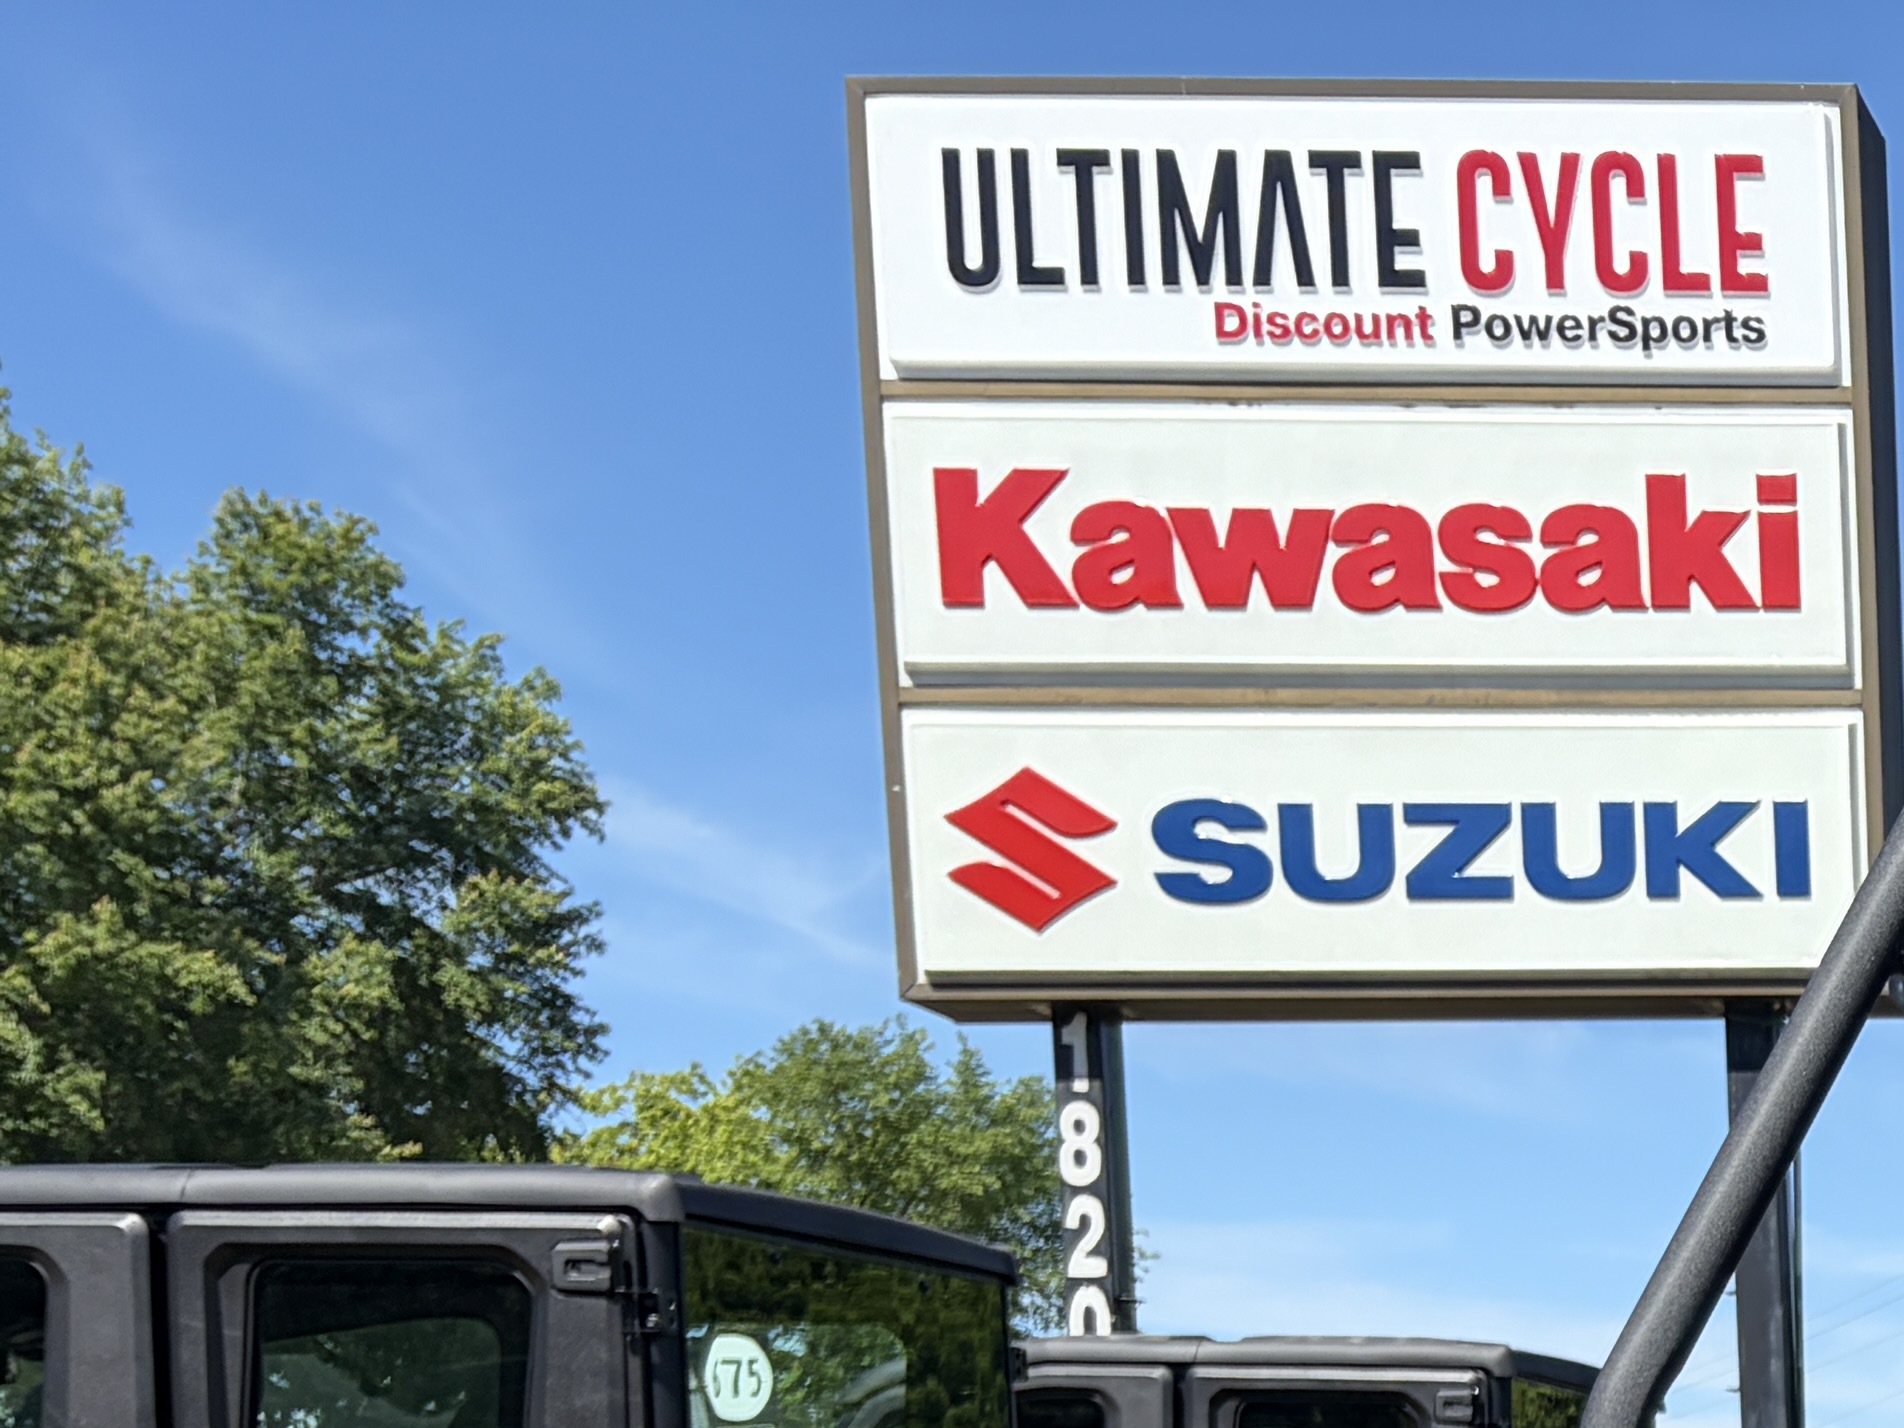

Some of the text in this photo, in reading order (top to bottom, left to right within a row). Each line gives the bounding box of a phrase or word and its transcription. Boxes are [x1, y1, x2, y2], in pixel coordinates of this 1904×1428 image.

[940, 147, 1770, 294] ULTIMATE CYCLE
[1214, 302, 1767, 352] Discount PowerSports
[932, 467, 1802, 613] Kawasaki
[1150, 798, 1813, 903] SUZUKI
